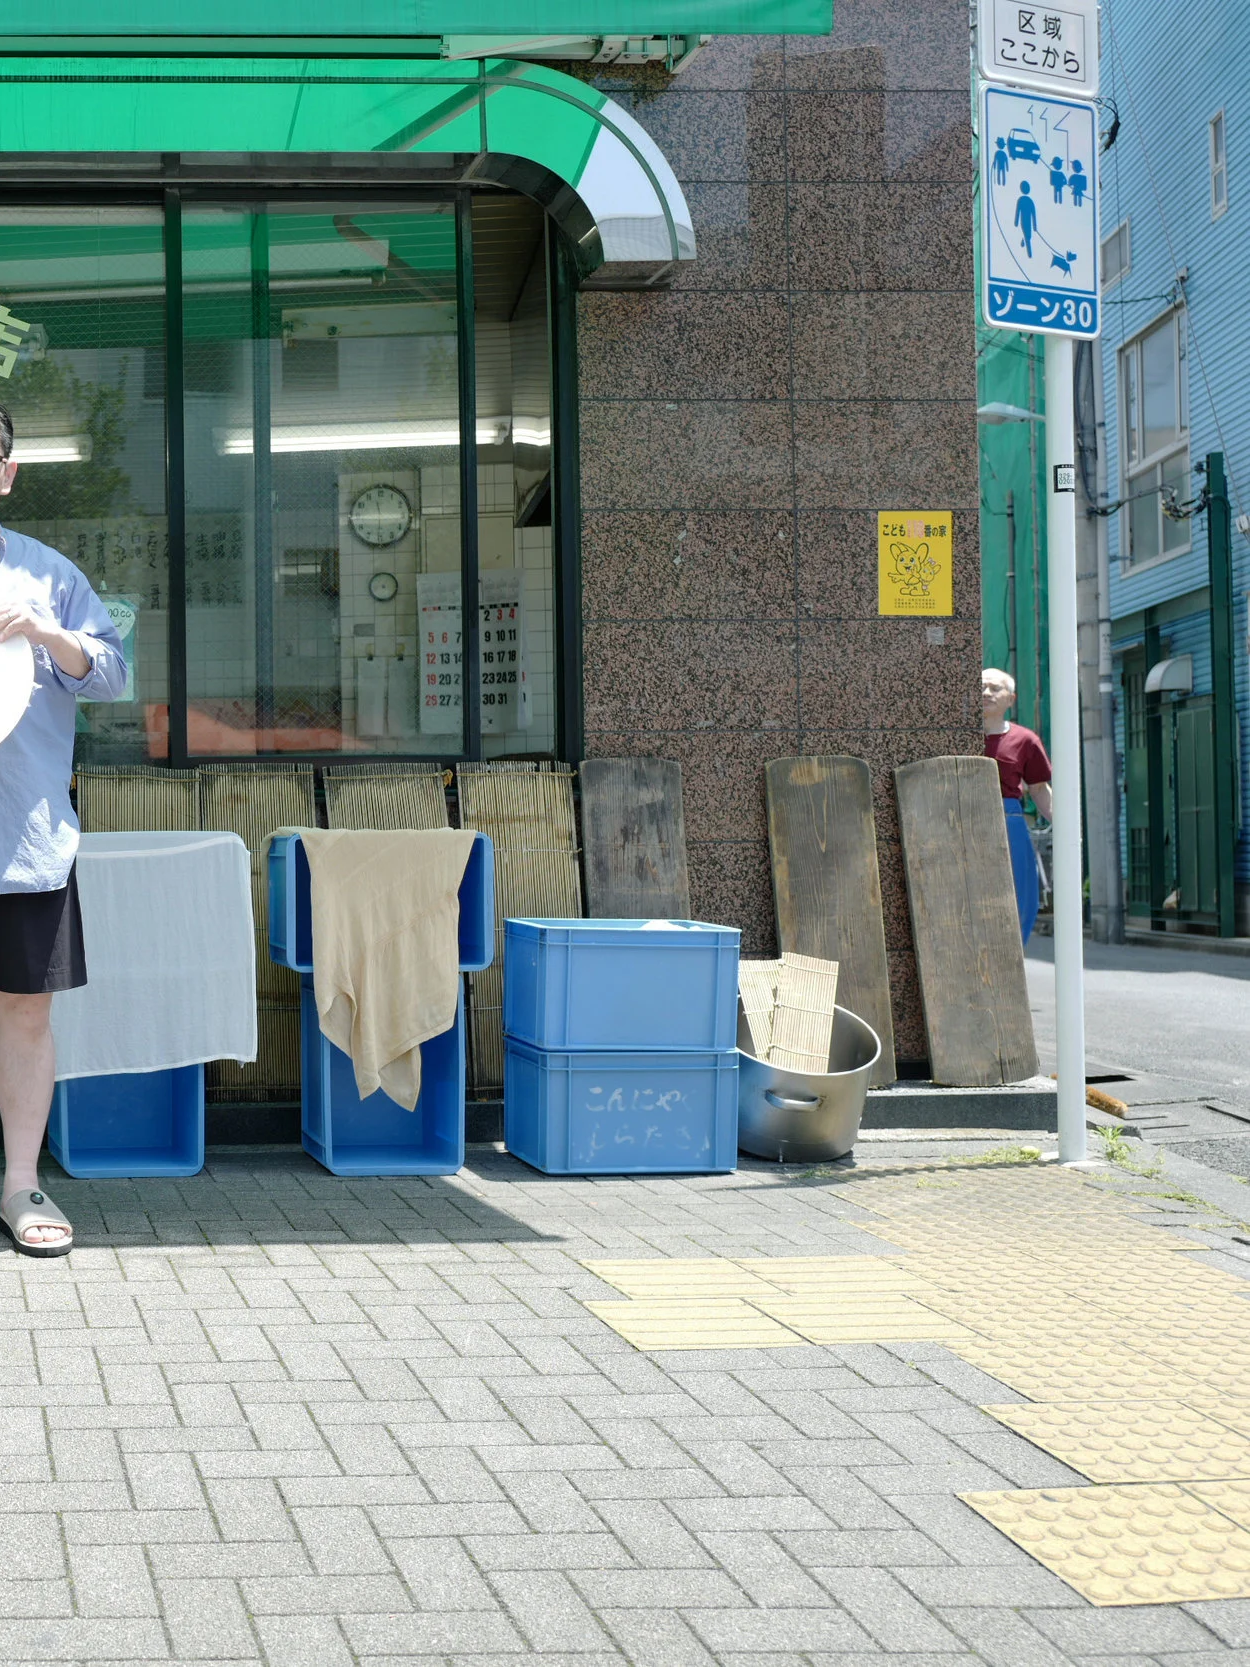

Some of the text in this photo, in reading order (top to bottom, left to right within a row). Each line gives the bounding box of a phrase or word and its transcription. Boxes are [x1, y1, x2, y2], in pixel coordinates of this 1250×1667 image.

[1018, 10, 1062, 41] 区域
[1000, 38, 1080, 73] ここから
[993, 290, 1093, 328] ゾーン30
[484, 608, 515, 621] 2 3 4
[428, 632, 435, 643] 5
[442, 632, 448, 643] 6
[484, 631, 491, 642] 9
[496, 630, 505, 641] 10
[508, 629, 516, 640] 11
[426, 653, 436, 664] 12
[440, 653, 450, 664] 13
[483, 652, 494, 663] 16
[496, 651, 505, 662] 17
[508, 650, 516, 661] 18
[426, 671, 517, 685] 19 20 2 23 24 25
[439, 695, 451, 706] 27
[482, 693, 495, 705] 30
[497, 693, 507, 704] 31
